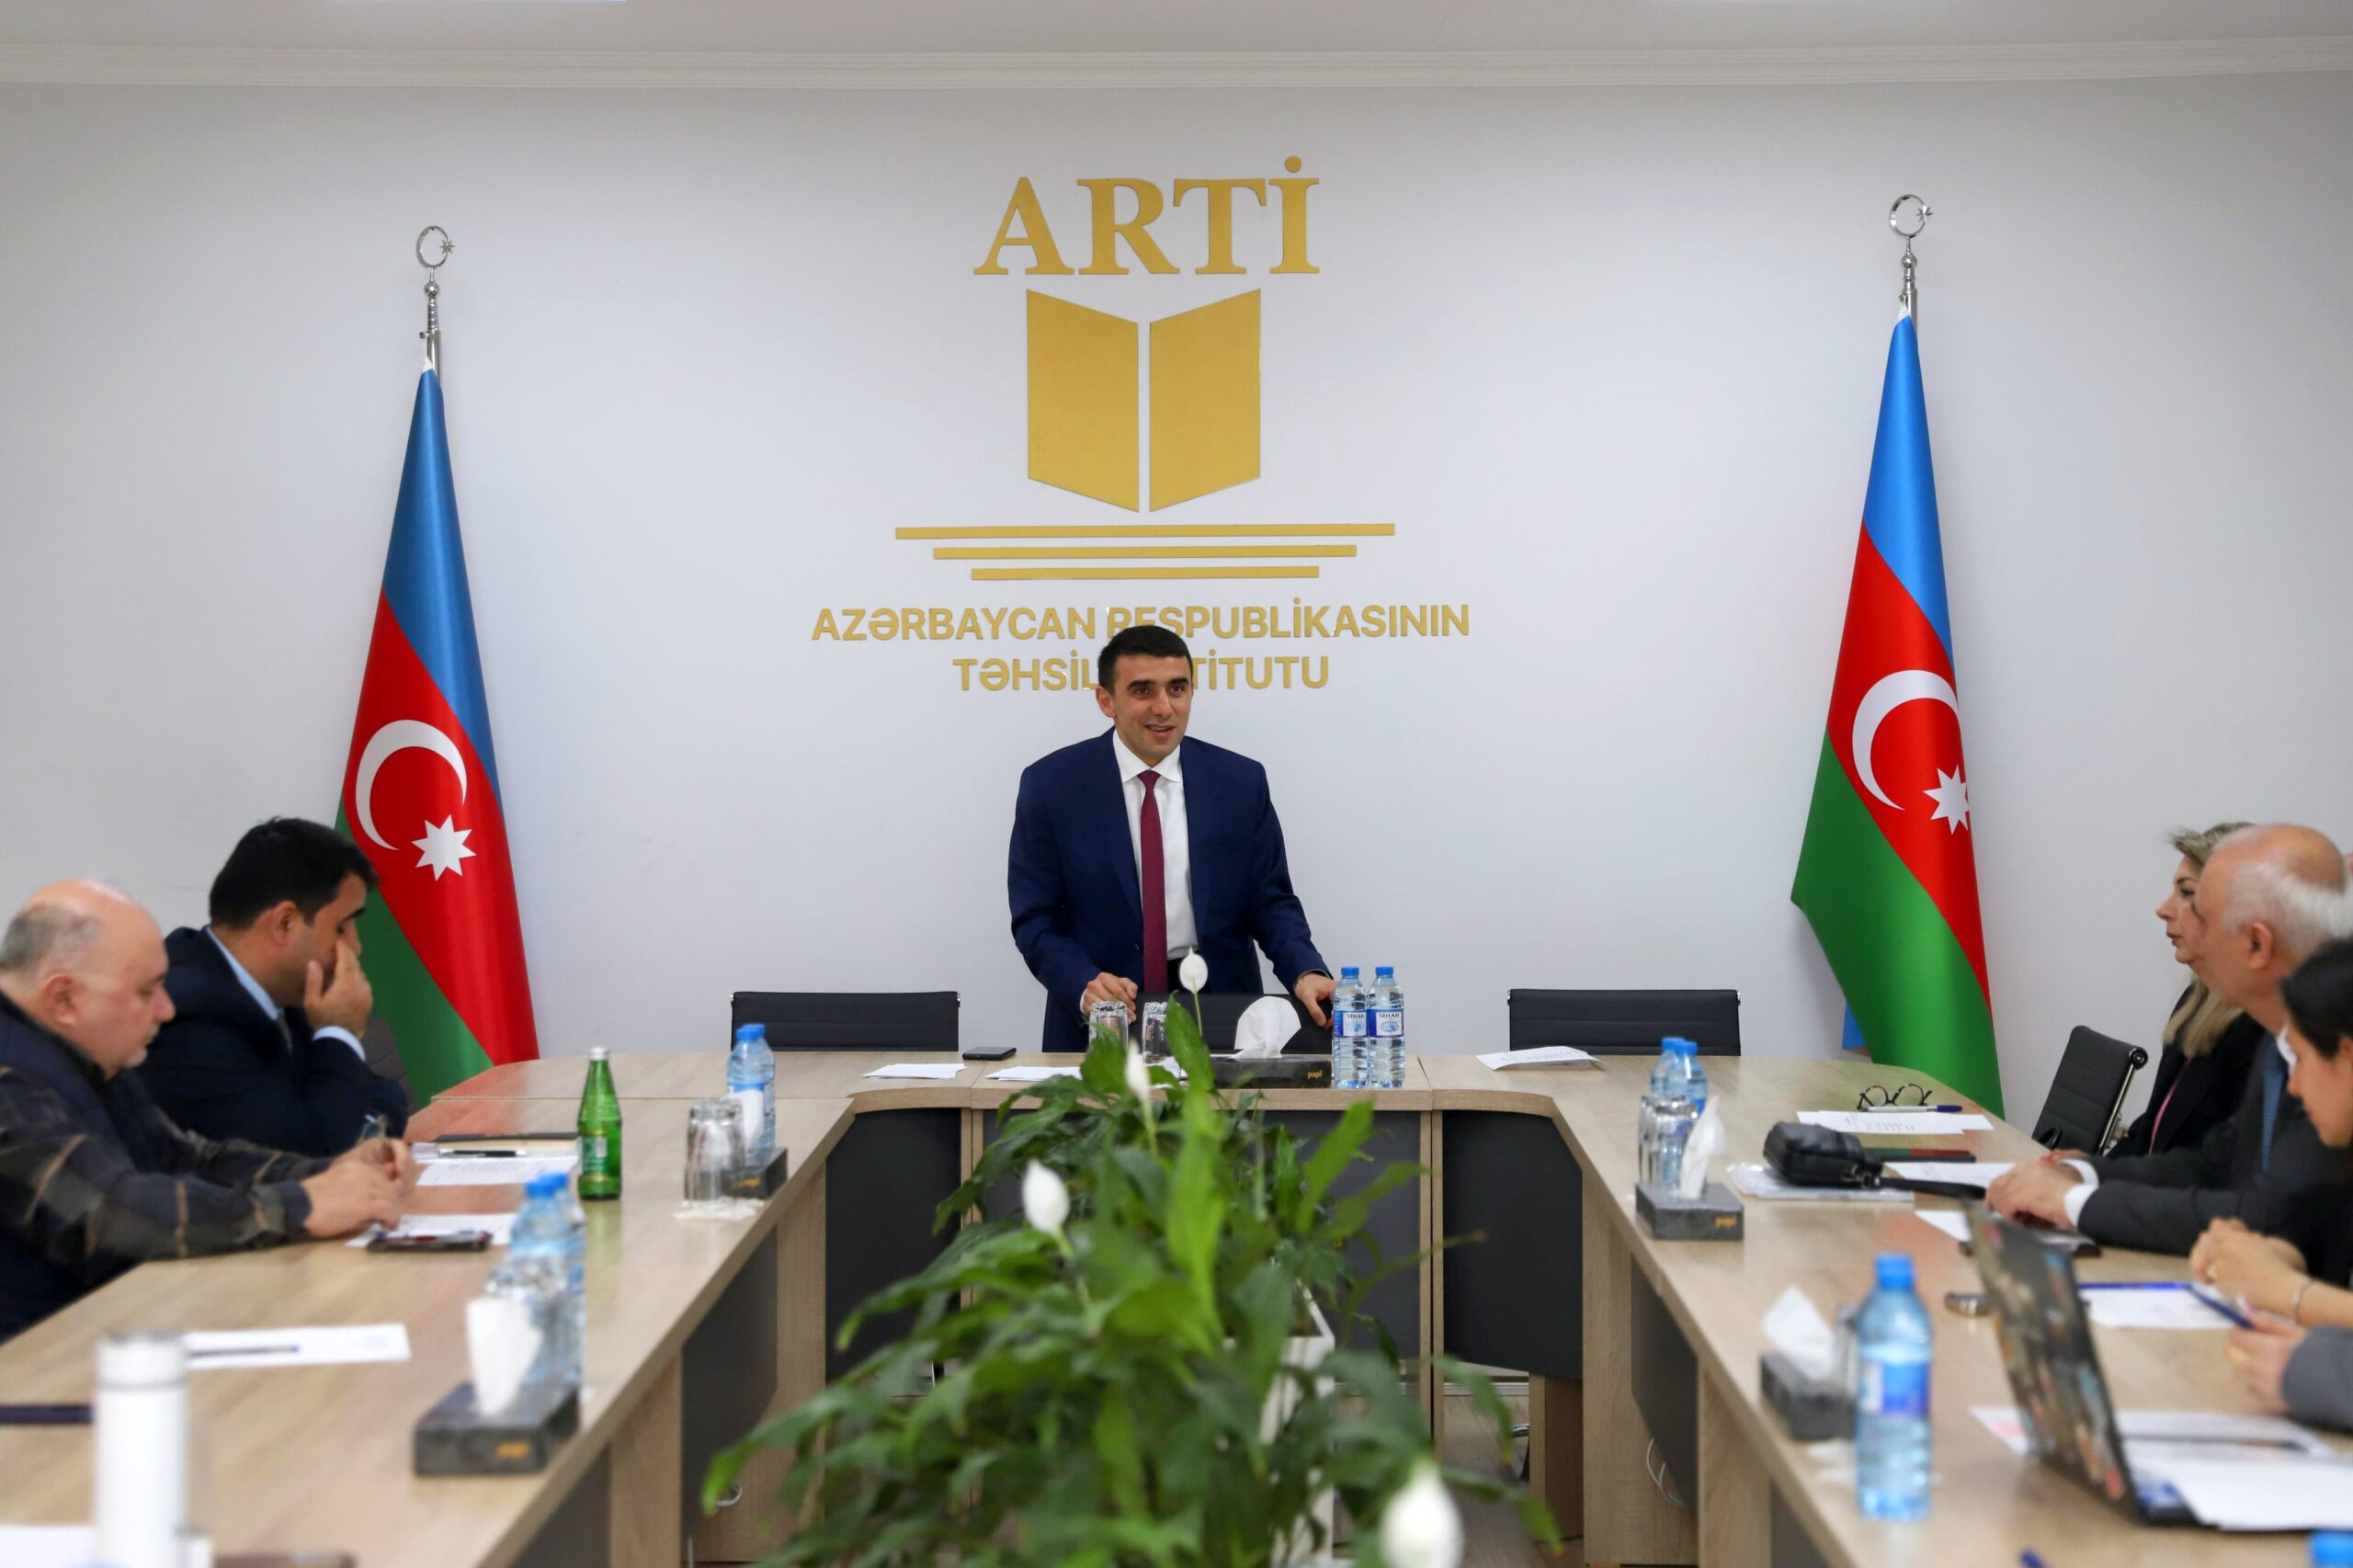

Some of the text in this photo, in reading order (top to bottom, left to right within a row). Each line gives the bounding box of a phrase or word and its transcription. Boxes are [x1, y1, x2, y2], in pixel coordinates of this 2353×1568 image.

[973, 155, 1320, 275] ARTİ
[812, 597, 1469, 641] AZƏRBAYCAN RESPUBLİKASININ
[952, 649, 1101, 691] TƏHSİL
